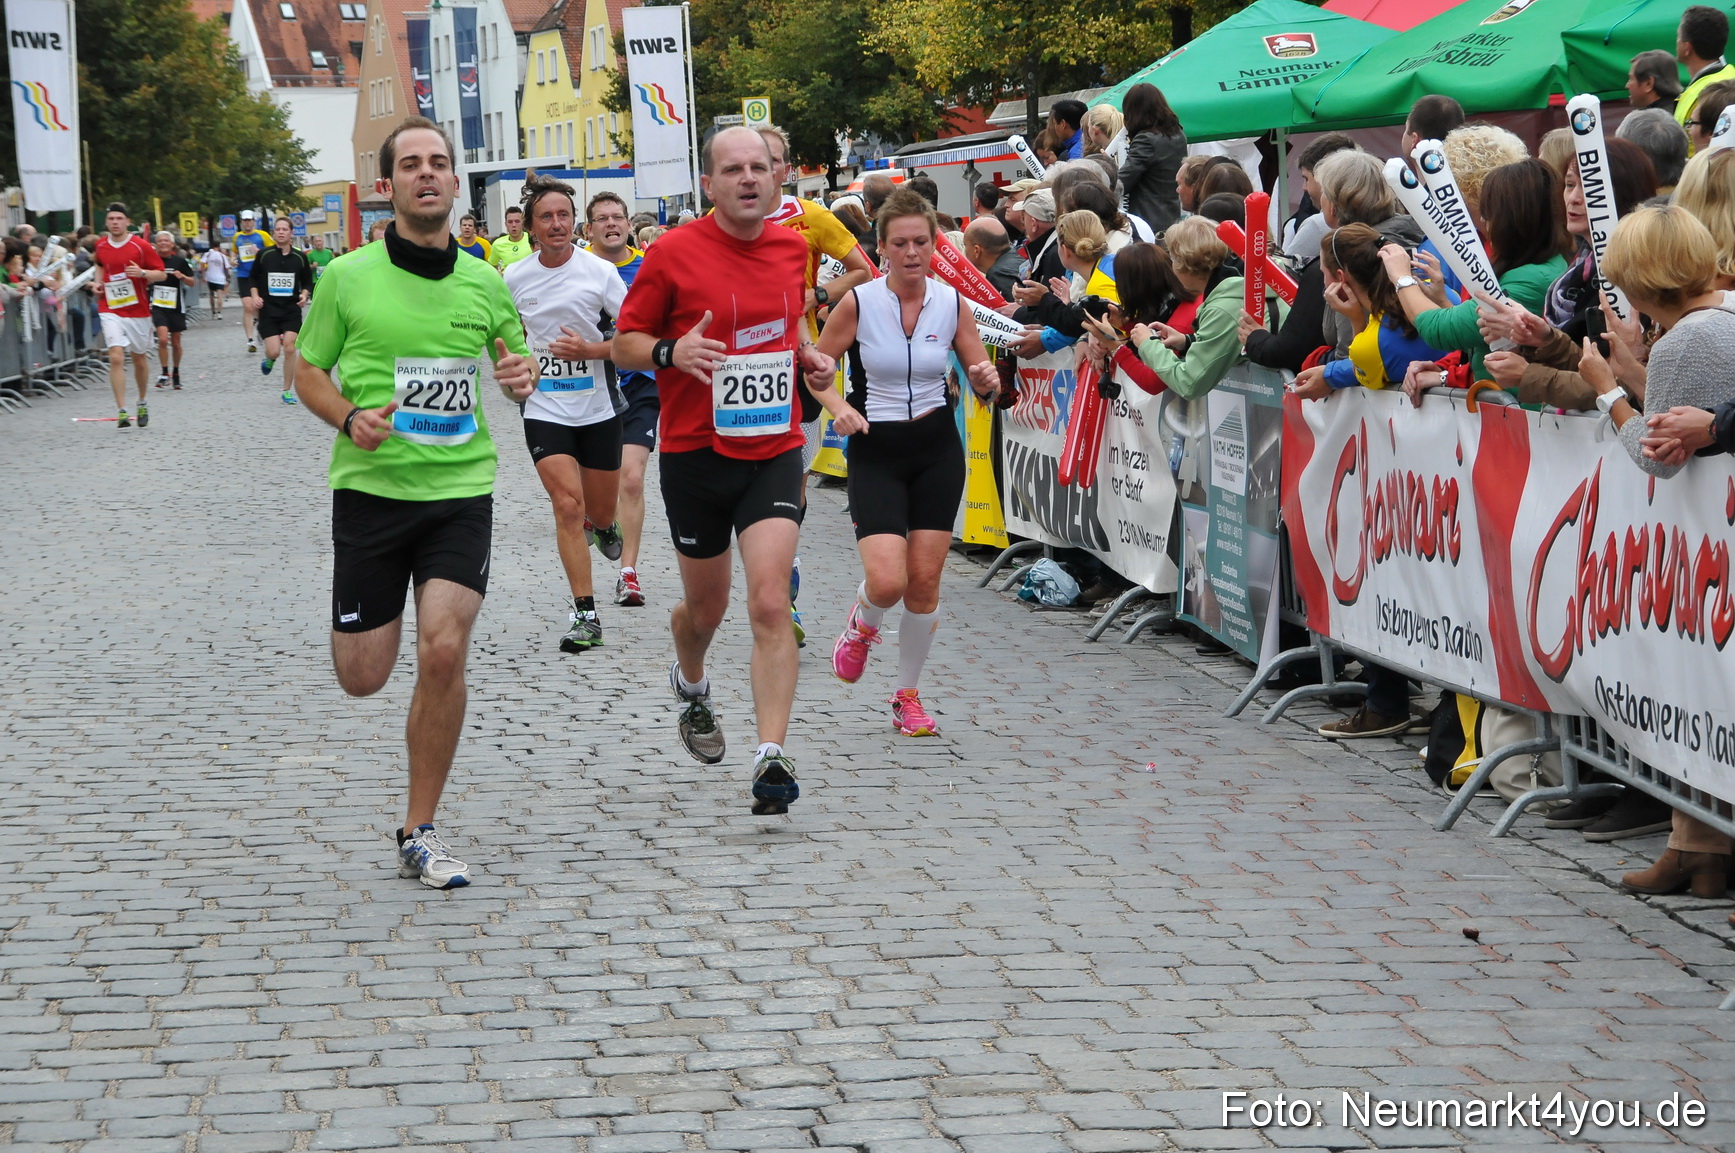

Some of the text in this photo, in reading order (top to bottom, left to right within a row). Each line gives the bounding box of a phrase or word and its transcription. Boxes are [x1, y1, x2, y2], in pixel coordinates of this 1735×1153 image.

[1239, 60, 1341, 78] Neumark
[1578, 149, 1608, 209] BMW
[1434, 183, 1472, 235] BMW
[270, 279, 293, 288] 2395
[961, 266, 978, 285] BKK
[111, 286, 129, 298] 145
[976, 283, 997, 302] Audi
[1253, 266, 1263, 319] Audi BKK
[750, 327, 773, 340] DEHN
[397, 366, 465, 376] PARTL Neumarkt
[539, 356, 588, 377] 2514
[720, 361, 784, 372] ARTL Neumarkt
[552, 381, 575, 390] Claus
[722, 371, 788, 405] 2636
[402, 379, 471, 412] 2223
[409, 417, 460, 433] Johannes
[731, 412, 783, 425] Johannes
[1526, 456, 1735, 684] Charivari
[1375, 593, 1483, 664] Ostbayerns Radio
[1595, 675, 1701, 752] Ostbayerns
